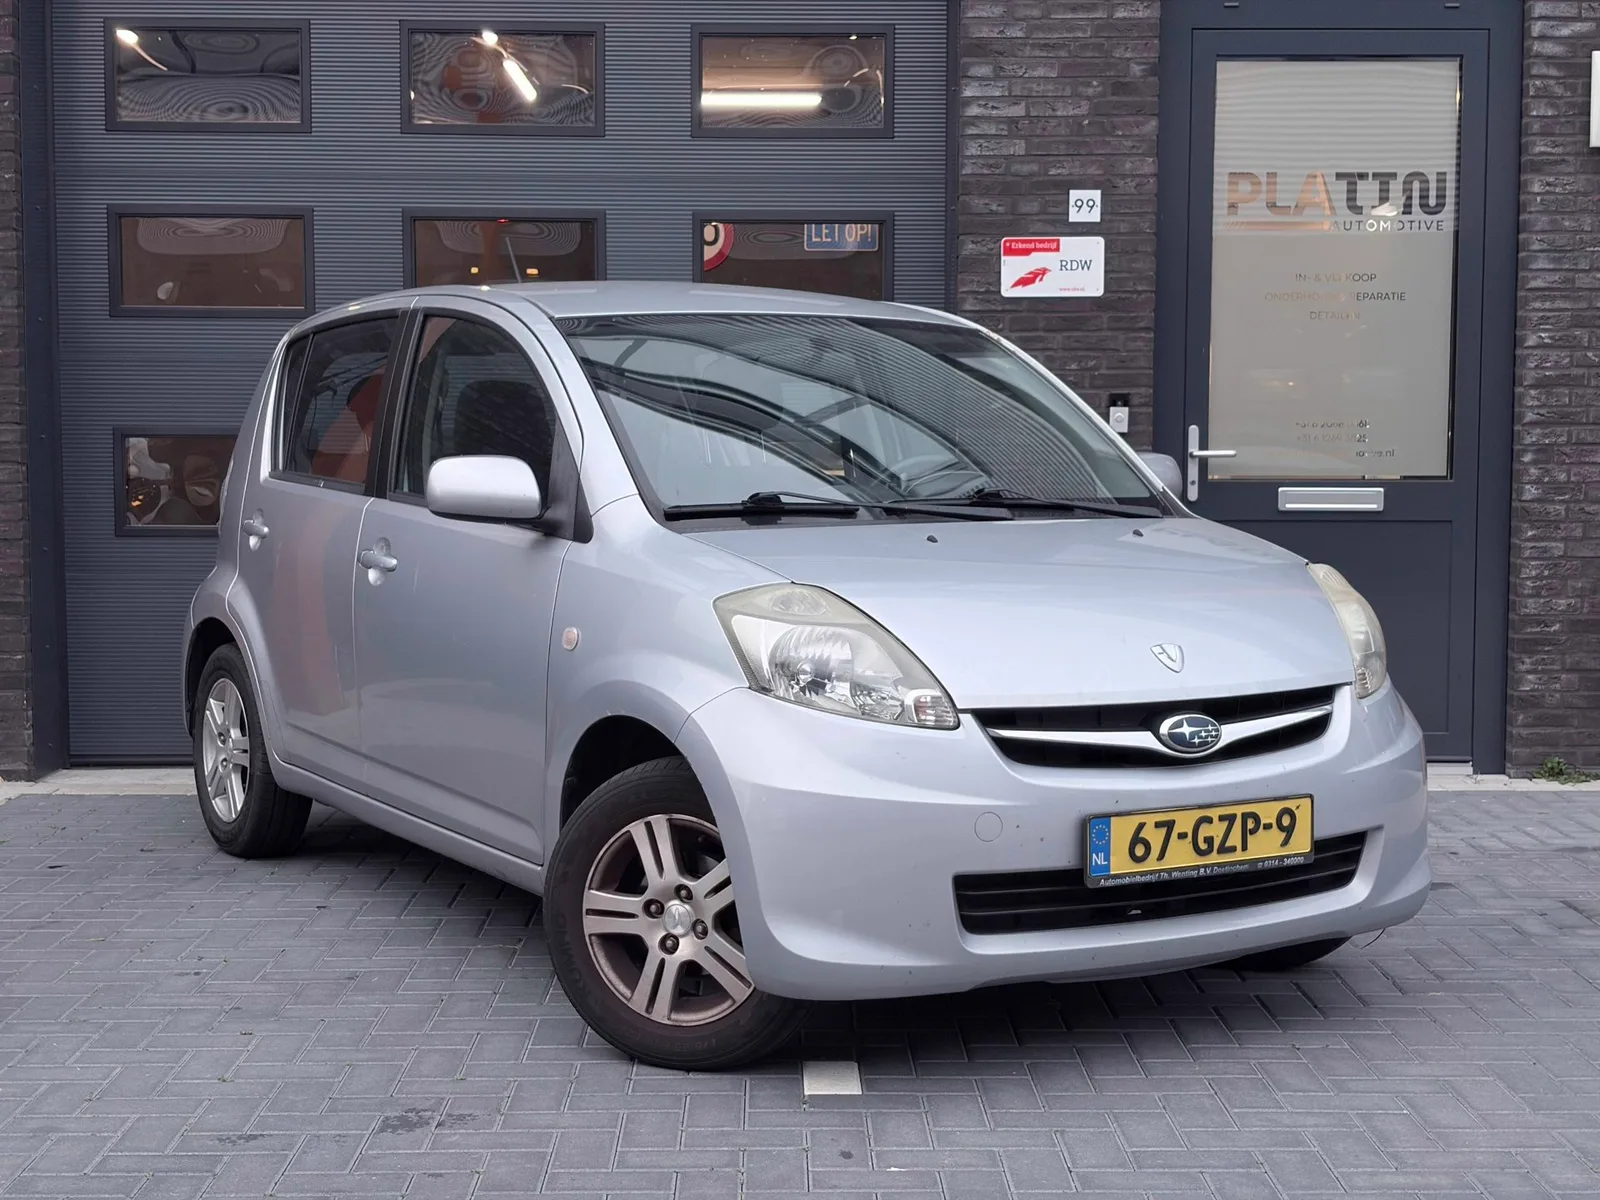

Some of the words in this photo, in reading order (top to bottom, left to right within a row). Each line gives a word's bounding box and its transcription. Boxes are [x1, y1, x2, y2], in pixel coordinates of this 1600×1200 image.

[1074, 199, 1096, 213] 99
[845, 224, 872, 241] OP!
[1332, 220, 1444, 231] AUTOMOTIVE
[1035, 241, 1058, 250] bedrijf
[1059, 259, 1092, 271] RDW
[1127, 807, 1297, 864] 67-GZP-9
[1092, 852, 1108, 867] NL
[1099, 872, 1159, 886] Automobielbedrijf
[1160, 871, 1170, 879] Th.
[1172, 868, 1198, 878] Wenting
